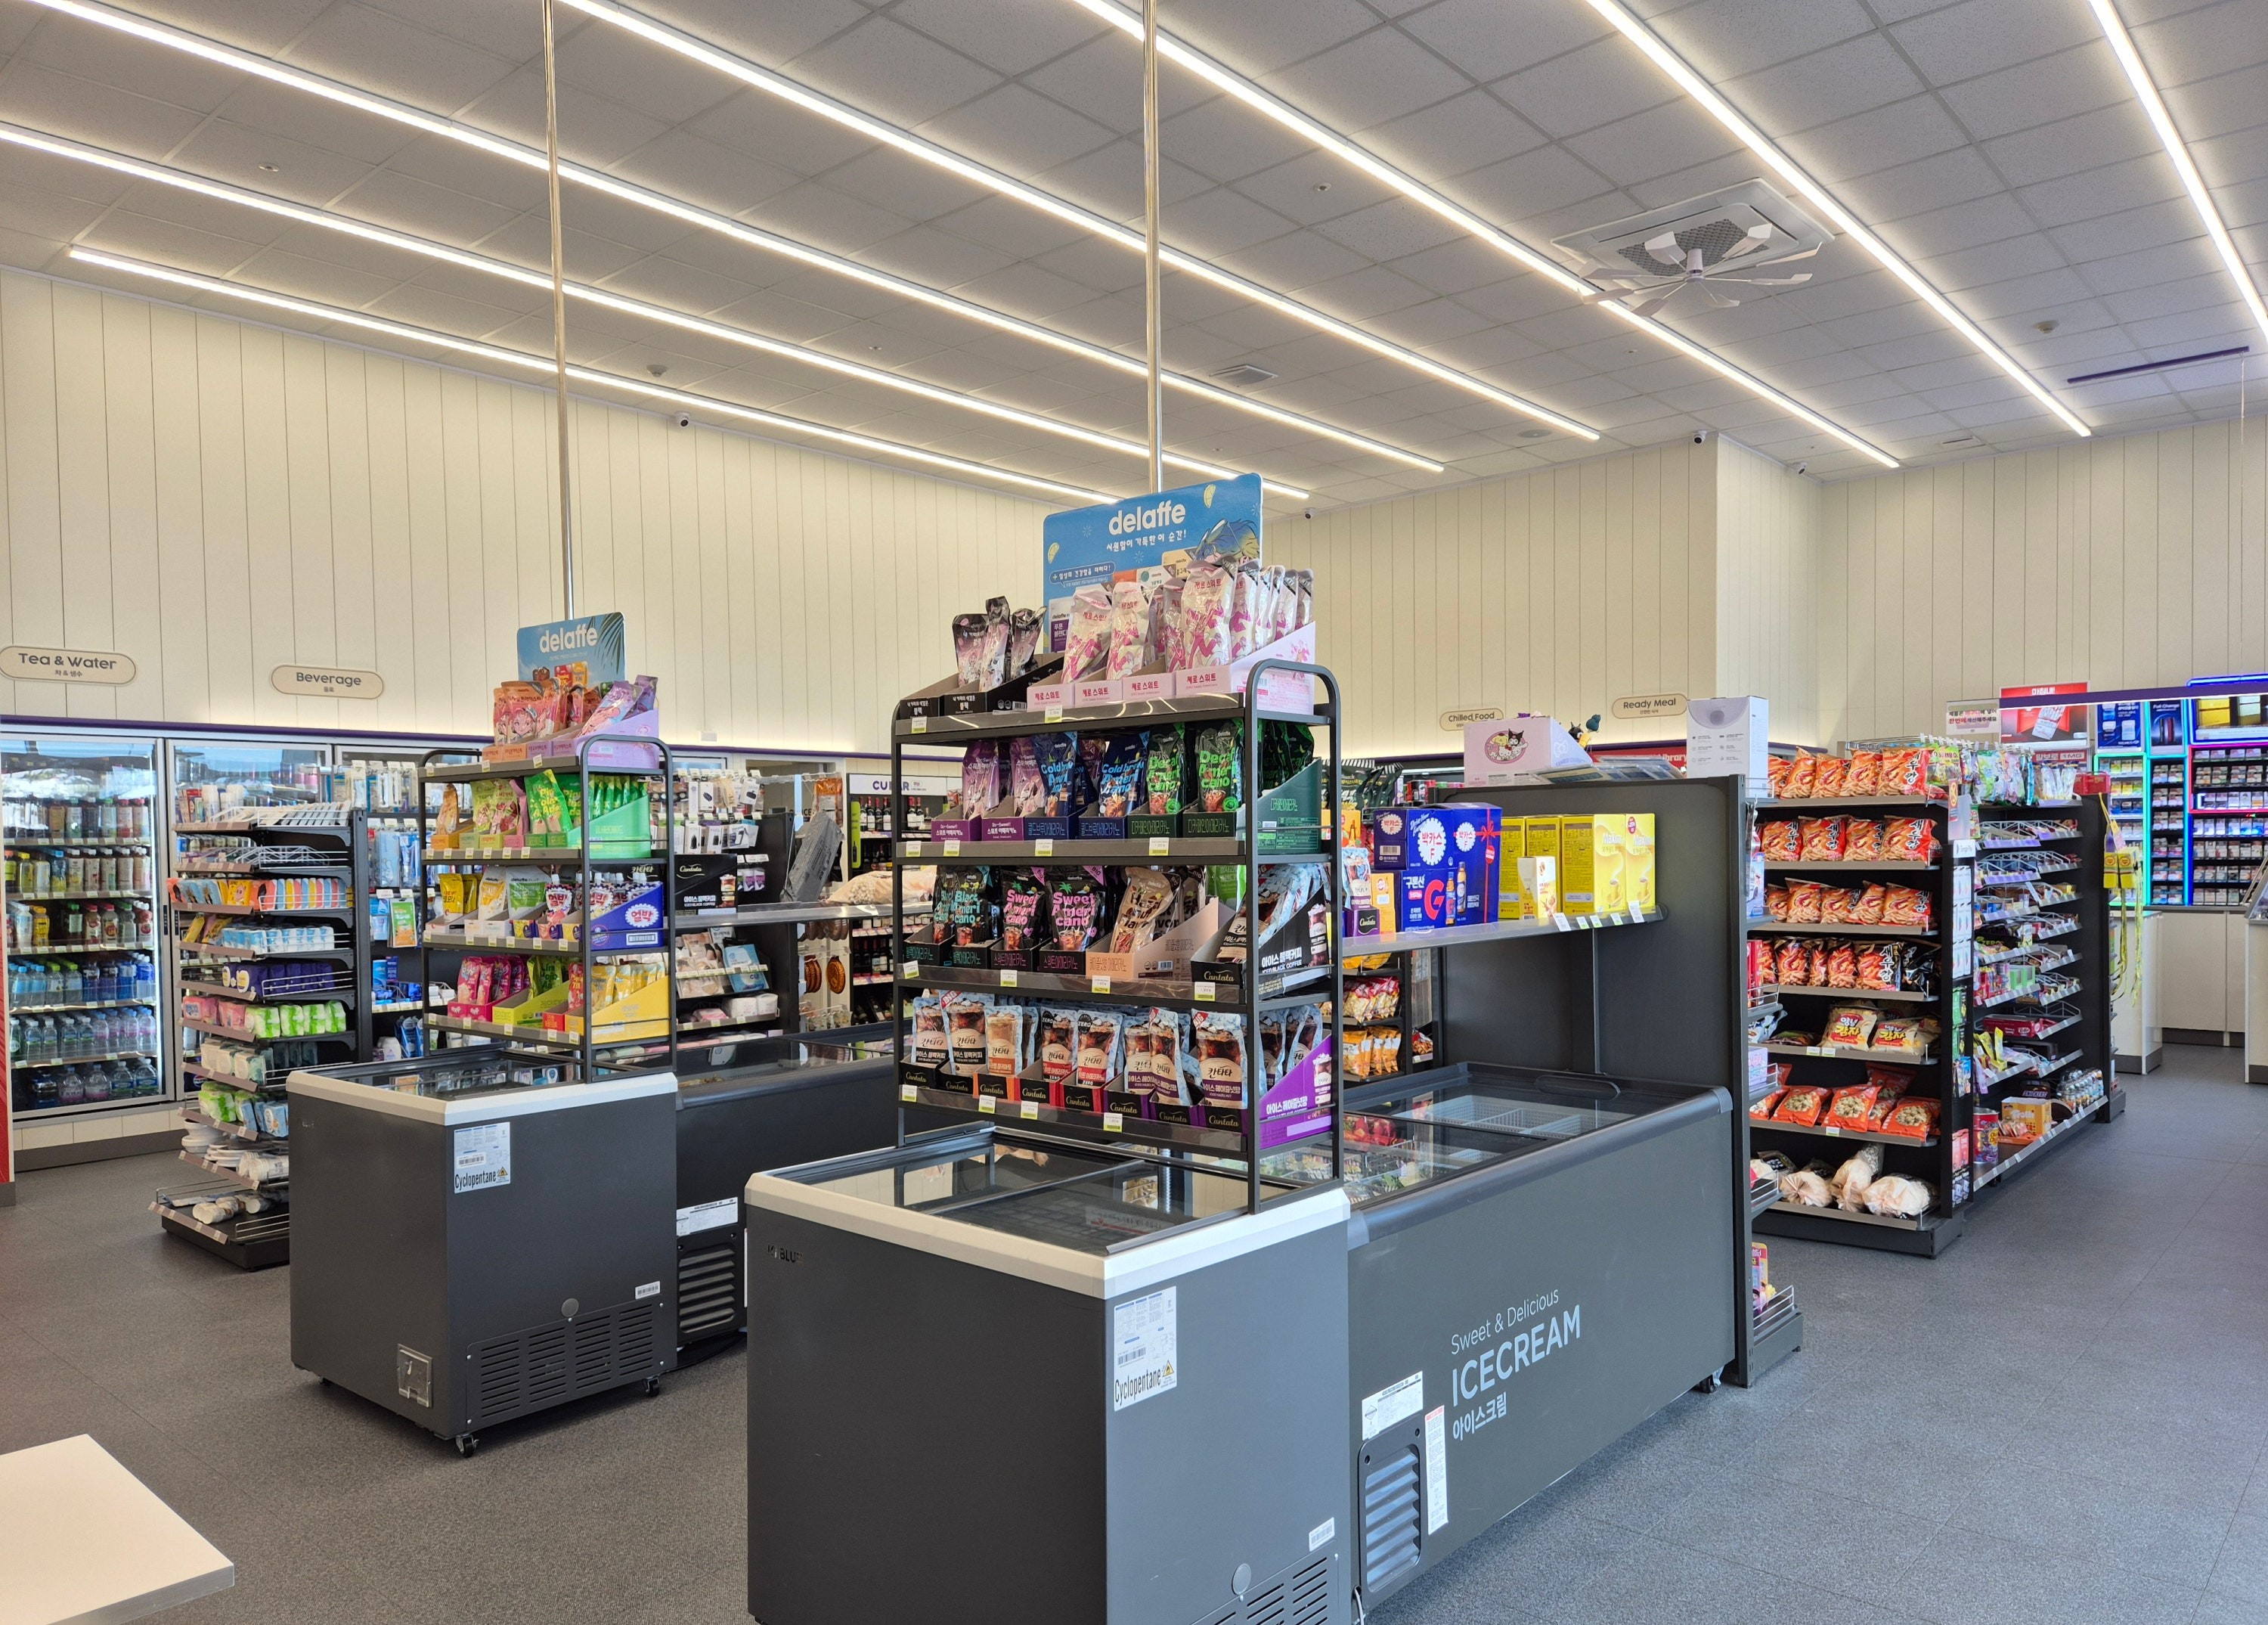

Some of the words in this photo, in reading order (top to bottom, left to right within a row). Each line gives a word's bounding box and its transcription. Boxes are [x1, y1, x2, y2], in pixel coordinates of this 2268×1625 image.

[1108, 500, 1186, 535] delaffe
[1106, 538, 1133, 552] 시원함이
[1135, 535, 1156, 547] 가득한
[1157, 534, 1165, 542] 이
[1168, 529, 1187, 543] 순간!
[539, 622, 598, 654] delaffe
[18, 653, 51, 665] Tea
[54, 655, 65, 665] &
[67, 656, 118, 670] Water
[296, 671, 362, 688] Beverage
[1186, 674, 1199, 684] 제로
[1199, 672, 1217, 683] 스위트
[1083, 688, 1093, 697] 제로
[1093, 686, 1110, 696] 스위트
[1131, 682, 1141, 692] 제로
[1142, 681, 1159, 691] 스위트
[1035, 692, 1045, 701] 제로
[1046, 690, 1061, 700] 스위트
[1623, 699, 1651, 711] Ready
[1653, 697, 1677, 708] Meal
[1448, 711, 1473, 723] Chilled
[1475, 711, 1495, 721] Food
[1149, 755, 1180, 769] Decaf
[1200, 748, 1237, 764] Decaf
[1101, 763, 1122, 774] Cold
[1905, 751, 1923, 785] 새우깡
[1201, 777, 1231, 789] cano
[1421, 832, 1443, 846] 박카스
[1458, 831, 1473, 839] 박카스
[1786, 821, 1799, 851] 새우깡
[1826, 823, 1839, 850] 새우깡
[1907, 818, 1925, 850] 새우깡
[1430, 848, 1435, 859] F
[1405, 876, 1426, 889] 구론산
[1007, 889, 1039, 904] Sweet
[1052, 892, 1096, 905] Sweet
[1424, 879, 1445, 921] G
[631, 910, 653, 923] 얼박
[1052, 904, 1095, 917] Ameri
[1055, 914, 1089, 927] cano
[1262, 953, 1280, 968] 아이스
[1279, 947, 1303, 963] 블랙커피
[1879, 944, 1895, 982] 새우깡
[1286, 960, 1303, 969] COFFEE
[1204, 971, 1235, 982] Cantata
[943, 991, 958, 1004] BIG
[1194, 1014, 1204, 1026] BIG
[1834, 1024, 1861, 1037] 감자
[956, 1037, 977, 1047] 칸타타
[992, 1046, 1010, 1056] 칸타타
[1048, 1052, 1064, 1062] 칸타타
[1156, 1063, 1171, 1075] 칸타타
[1207, 1067, 1233, 1078] 칸타타
[906, 1072, 927, 1083] Cantata
[946, 1081, 968, 1092] Cantata
[980, 1084, 1004, 1095] Cantata
[1022, 1087, 1046, 1099] Cantata
[1215, 1084, 1241, 1094] 헤이즐넛향
[1066, 1096, 1090, 1107] Cantata
[1110, 1102, 1138, 1114] Cantata
[1266, 1101, 1284, 1115] 아이스
[1283, 1096, 1308, 1112] 헤이즐넛향
[1159, 1111, 1188, 1124] Cantata
[1209, 1115, 1239, 1127] Cantata
[455, 1171, 497, 1191] Cyclopentane
[1451, 1322, 1492, 1356] Sweet
[1494, 1313, 1504, 1334] &
[1506, 1289, 1560, 1328] Delicious
[1452, 1304, 1581, 1407] ICECREAM
[1114, 1368, 1161, 1406] Cyclopentane
[1452, 1391, 1507, 1441] 아이스크림
